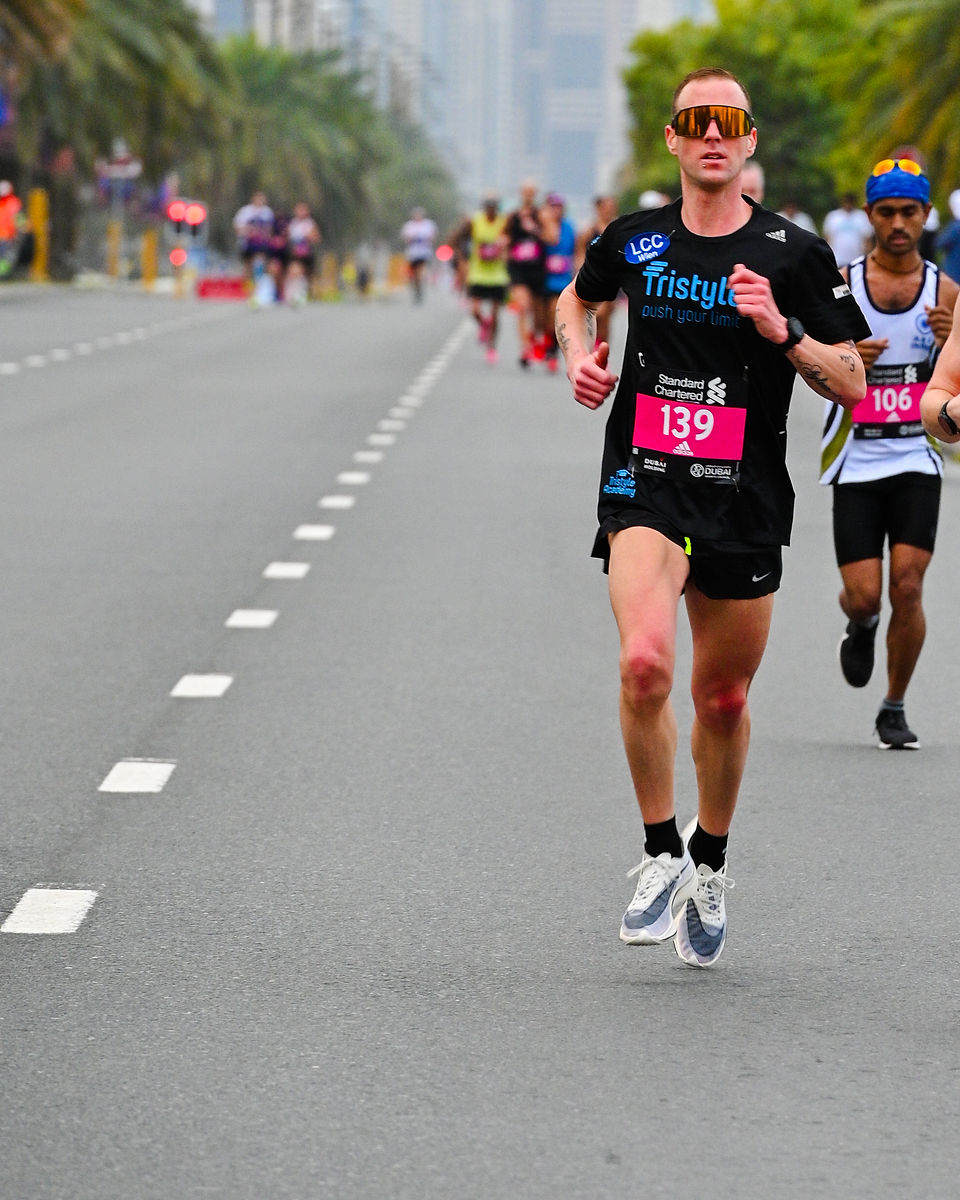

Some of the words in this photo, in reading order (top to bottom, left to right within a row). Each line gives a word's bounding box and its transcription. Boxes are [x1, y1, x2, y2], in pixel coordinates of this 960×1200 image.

[630, 234, 664, 256] LCC
[641, 305, 674, 319] push
[677, 309, 708, 324] your
[658, 373, 705, 390] Standard
[654, 384, 704, 401] Chartered
[872, 387, 912, 412] 106
[661, 404, 715, 441] 139
[705, 467, 732, 476] DUBAI
